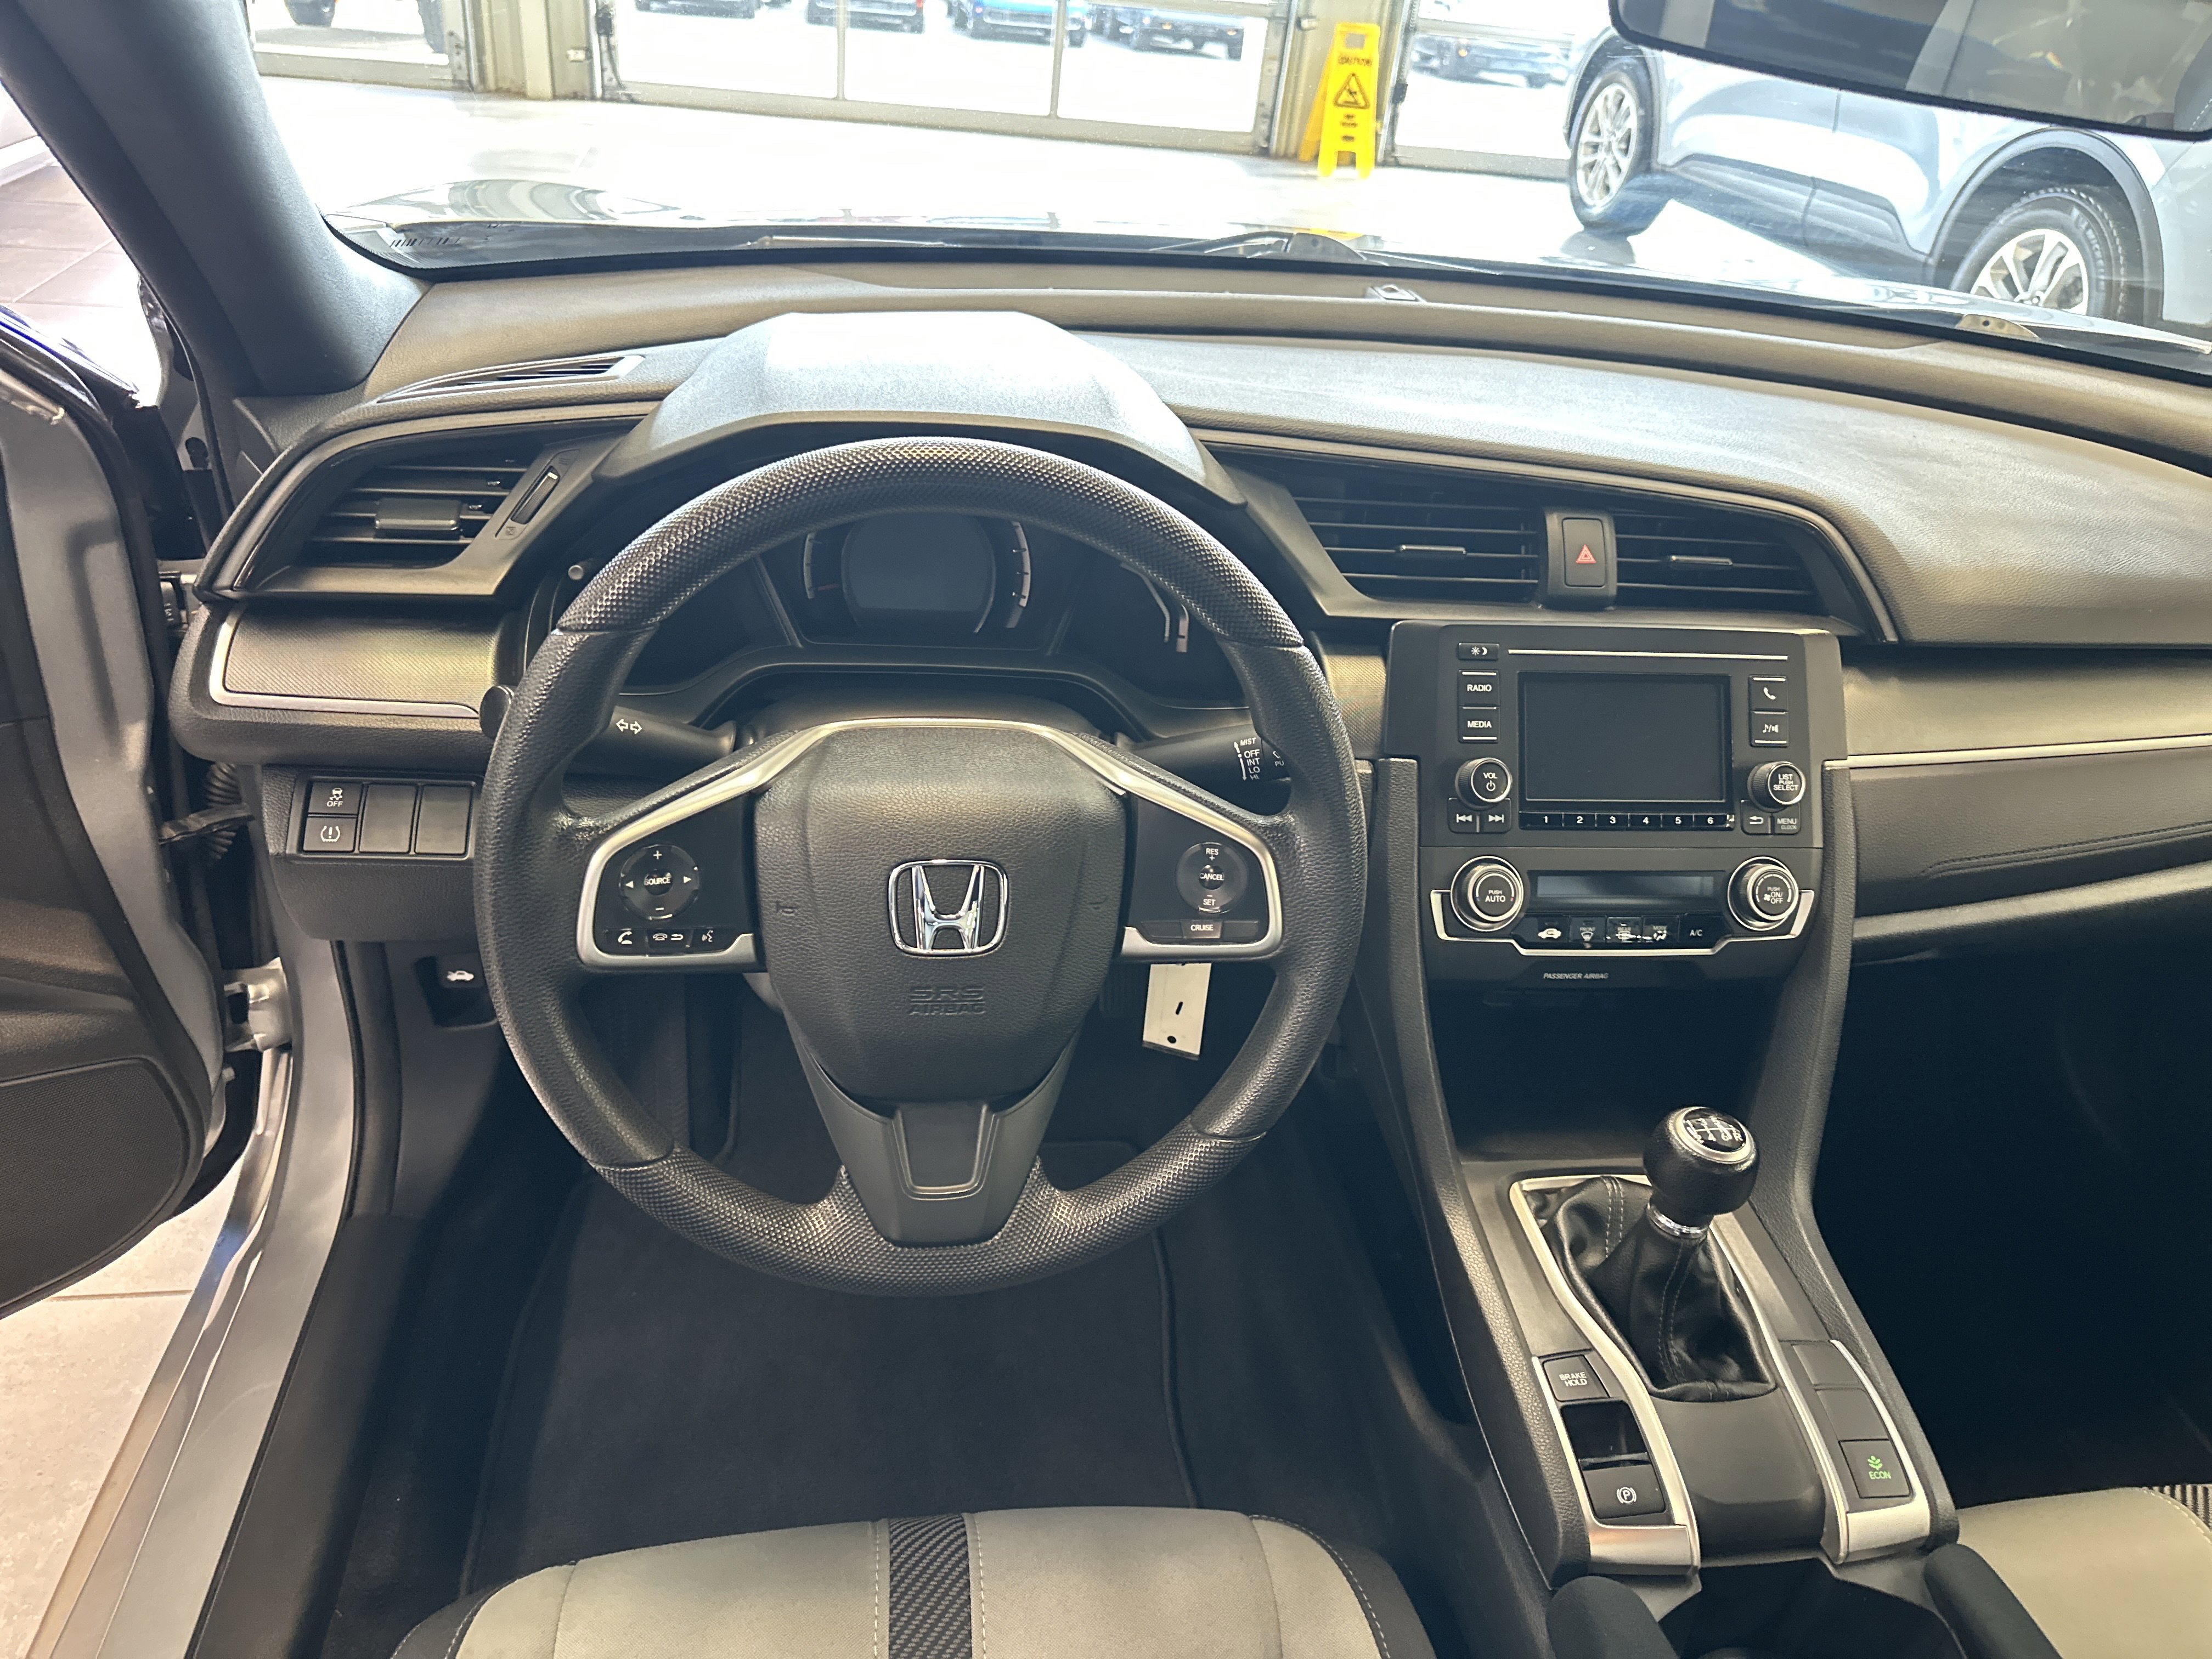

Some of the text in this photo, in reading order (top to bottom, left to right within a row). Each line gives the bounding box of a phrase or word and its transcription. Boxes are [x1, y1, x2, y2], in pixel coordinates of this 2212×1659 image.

[1240, 737, 1257, 746] MIST
[1244, 749, 1260, 758] OFF
[1246, 758, 1260, 766] INT
[1576, 816, 1583, 824] 2
[1642, 816, 1649, 825] 4
[1675, 816, 1681, 825] 5
[644, 877, 671, 886] SOURCE
[1199, 873, 1224, 881] CANCEL
[1689, 929, 1703, 937] A/C
[909, 987, 984, 1001] SRS
[907, 1004, 985, 1015] AIRBAG
[1698, 1118, 1707, 1126] 3
[1712, 1117, 1720, 1125] 5
[1708, 1133, 1716, 1142] 4
[1721, 1132, 1729, 1141] 6
[1733, 1132, 1743, 1141] R
[1559, 1372, 1587, 1381] BRAKE
[1564, 1378, 1587, 1387] HOLD
[1869, 1471, 1892, 1480] ECON
